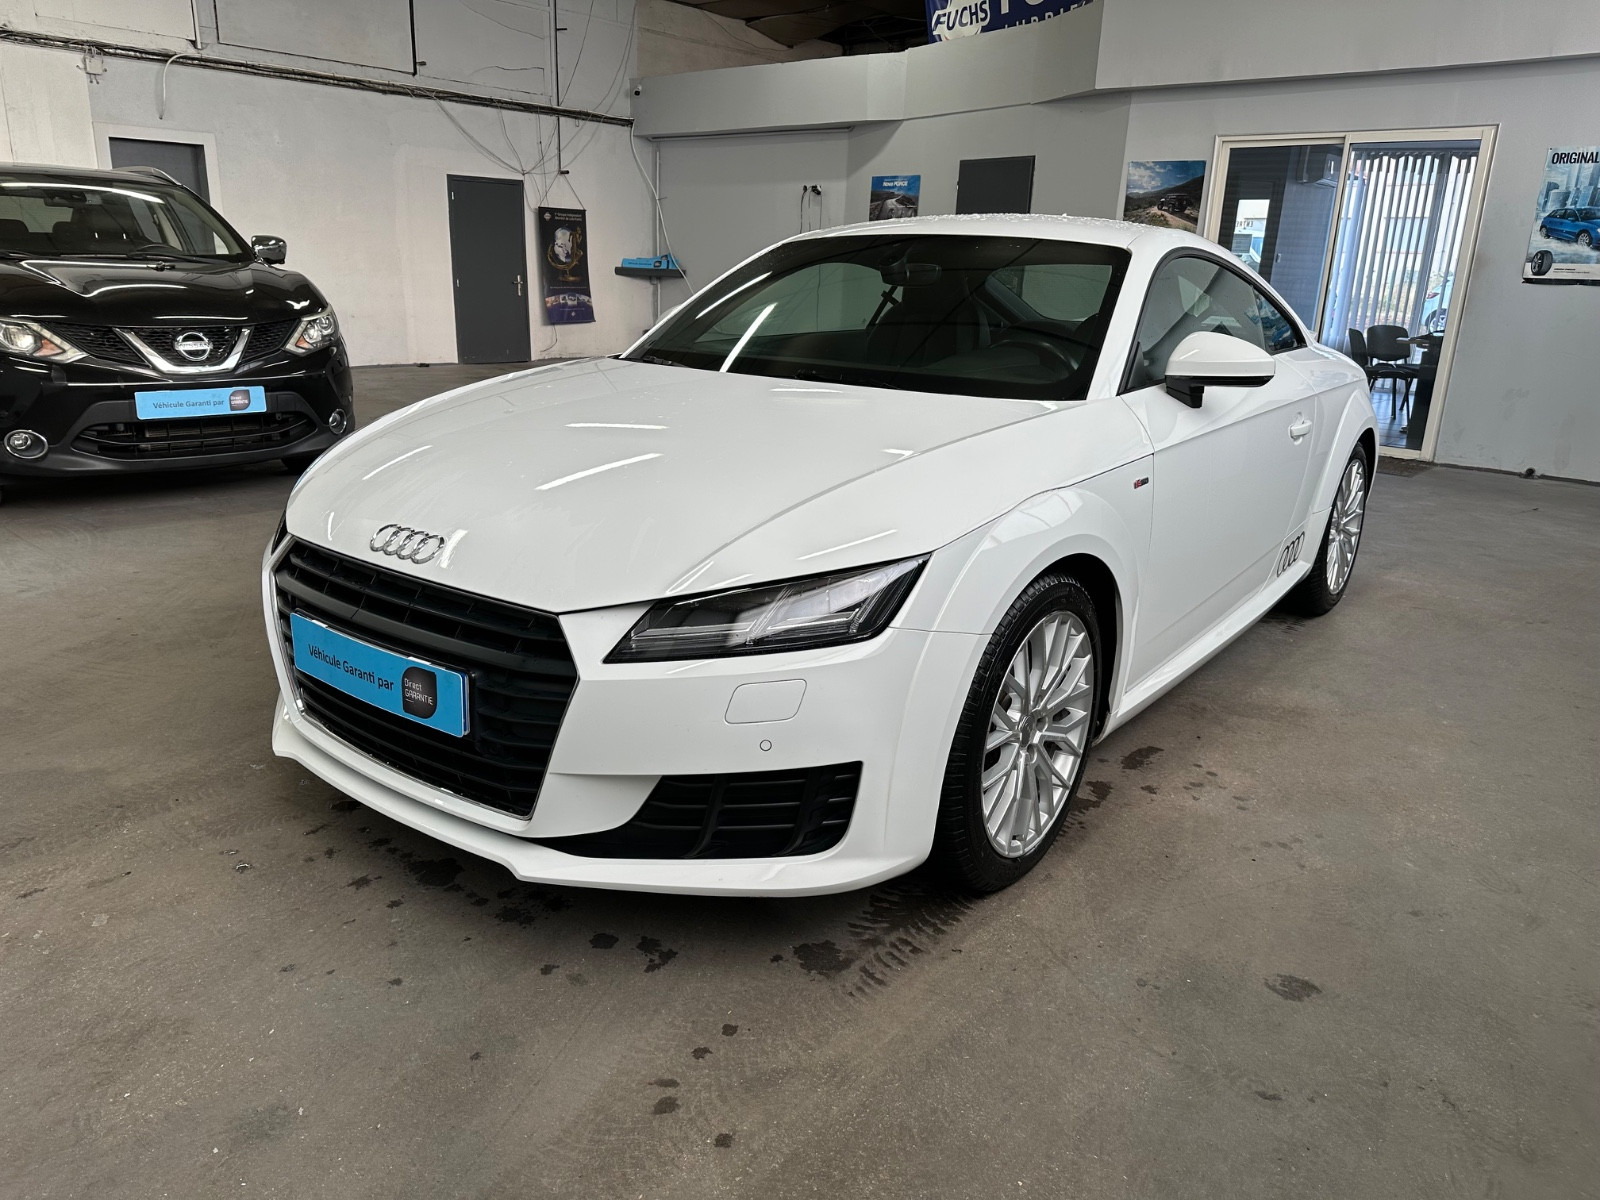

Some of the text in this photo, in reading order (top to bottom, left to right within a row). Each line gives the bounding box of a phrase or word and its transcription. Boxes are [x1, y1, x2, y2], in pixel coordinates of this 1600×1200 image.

[933, 0, 989, 31] FUCHS
[1551, 152, 1600, 164] ORIGINAL
[152, 400, 184, 409] Véhicule
[185, 400, 212, 408] Garanti
[308, 643, 395, 692] Véhicule Garanti par
[404, 677, 423, 692] Direct
[404, 688, 434, 706] GARANTIE
